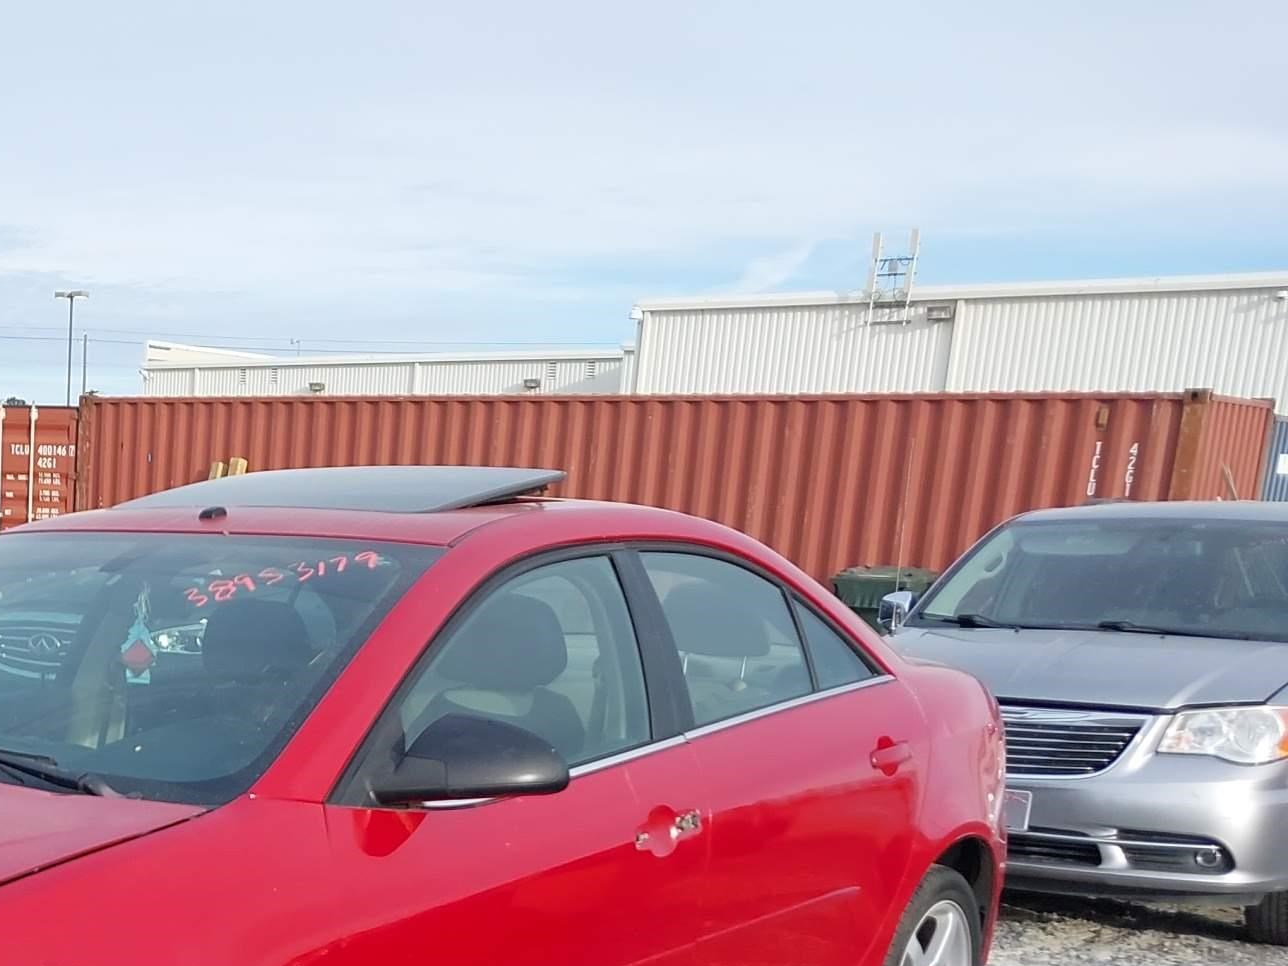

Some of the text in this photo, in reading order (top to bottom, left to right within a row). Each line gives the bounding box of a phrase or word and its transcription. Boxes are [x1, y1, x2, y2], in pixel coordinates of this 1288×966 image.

[10, 443, 30, 455] TCLU
[37, 444, 67, 457] 400146
[37, 457, 57, 469] 42G1
[1087, 441, 1103, 496] TCLU
[1124, 442, 1140, 497] 42G1
[184, 551, 381, 607] 38953179
